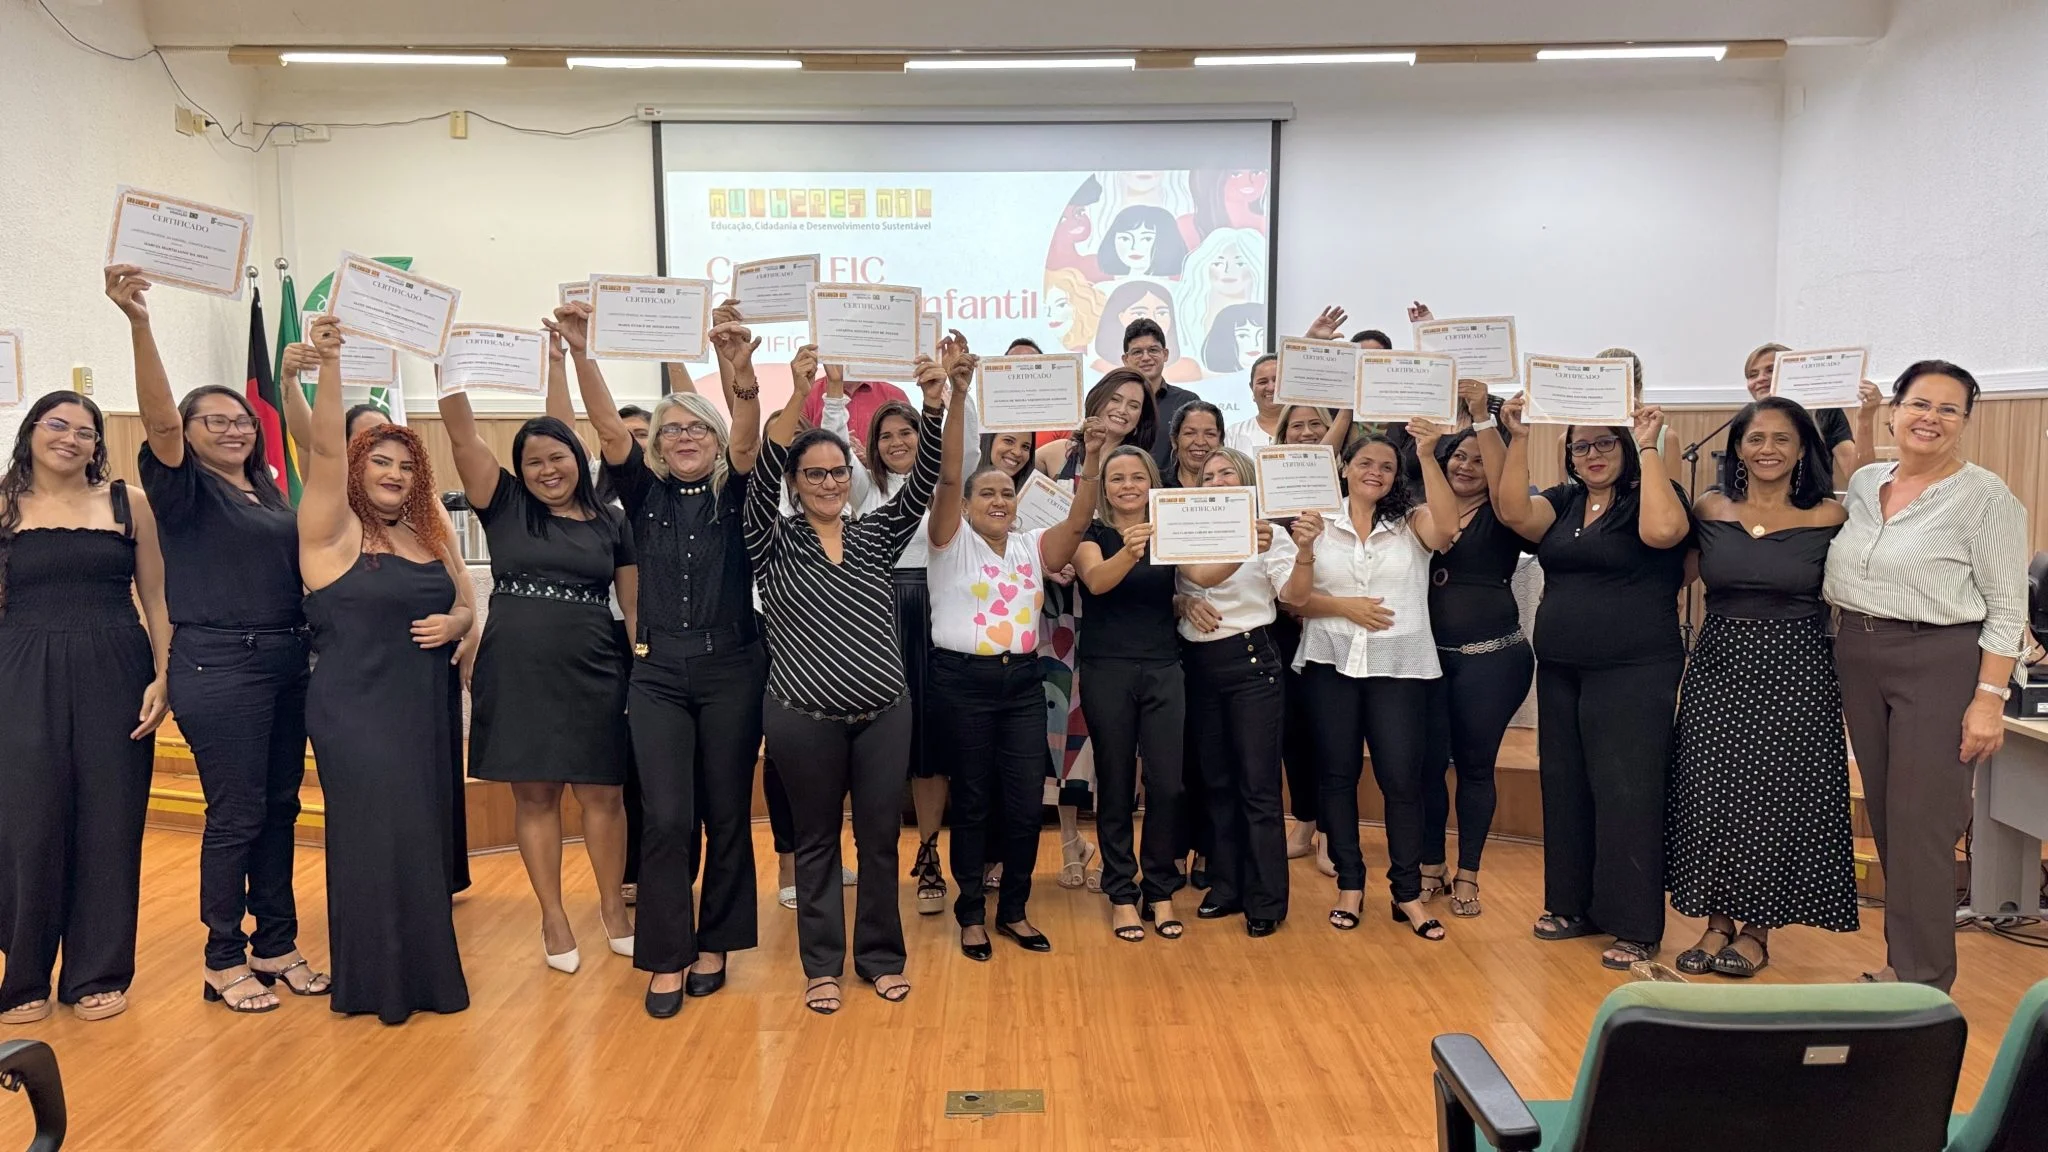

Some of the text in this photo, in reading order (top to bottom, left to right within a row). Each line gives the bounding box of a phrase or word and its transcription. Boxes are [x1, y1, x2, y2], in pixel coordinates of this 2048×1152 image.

[152, 214, 209, 233] CERTIFICADO
[755, 221, 798, 231] Cidadania
[806, 221, 881, 231] Desenvolvimento
[882, 221, 932, 231] Sustentável
[830, 256, 885, 284] FIC
[372, 280, 422, 302] CERTIFICADO
[625, 296, 676, 305] CERTIFICADO
[921, 288, 1037, 320] nfantil
[843, 302, 891, 311] CERTIFICADO
[1007, 372, 1052, 380] CERTIFICADO
[1181, 504, 1226, 512] CERTIFICADO
